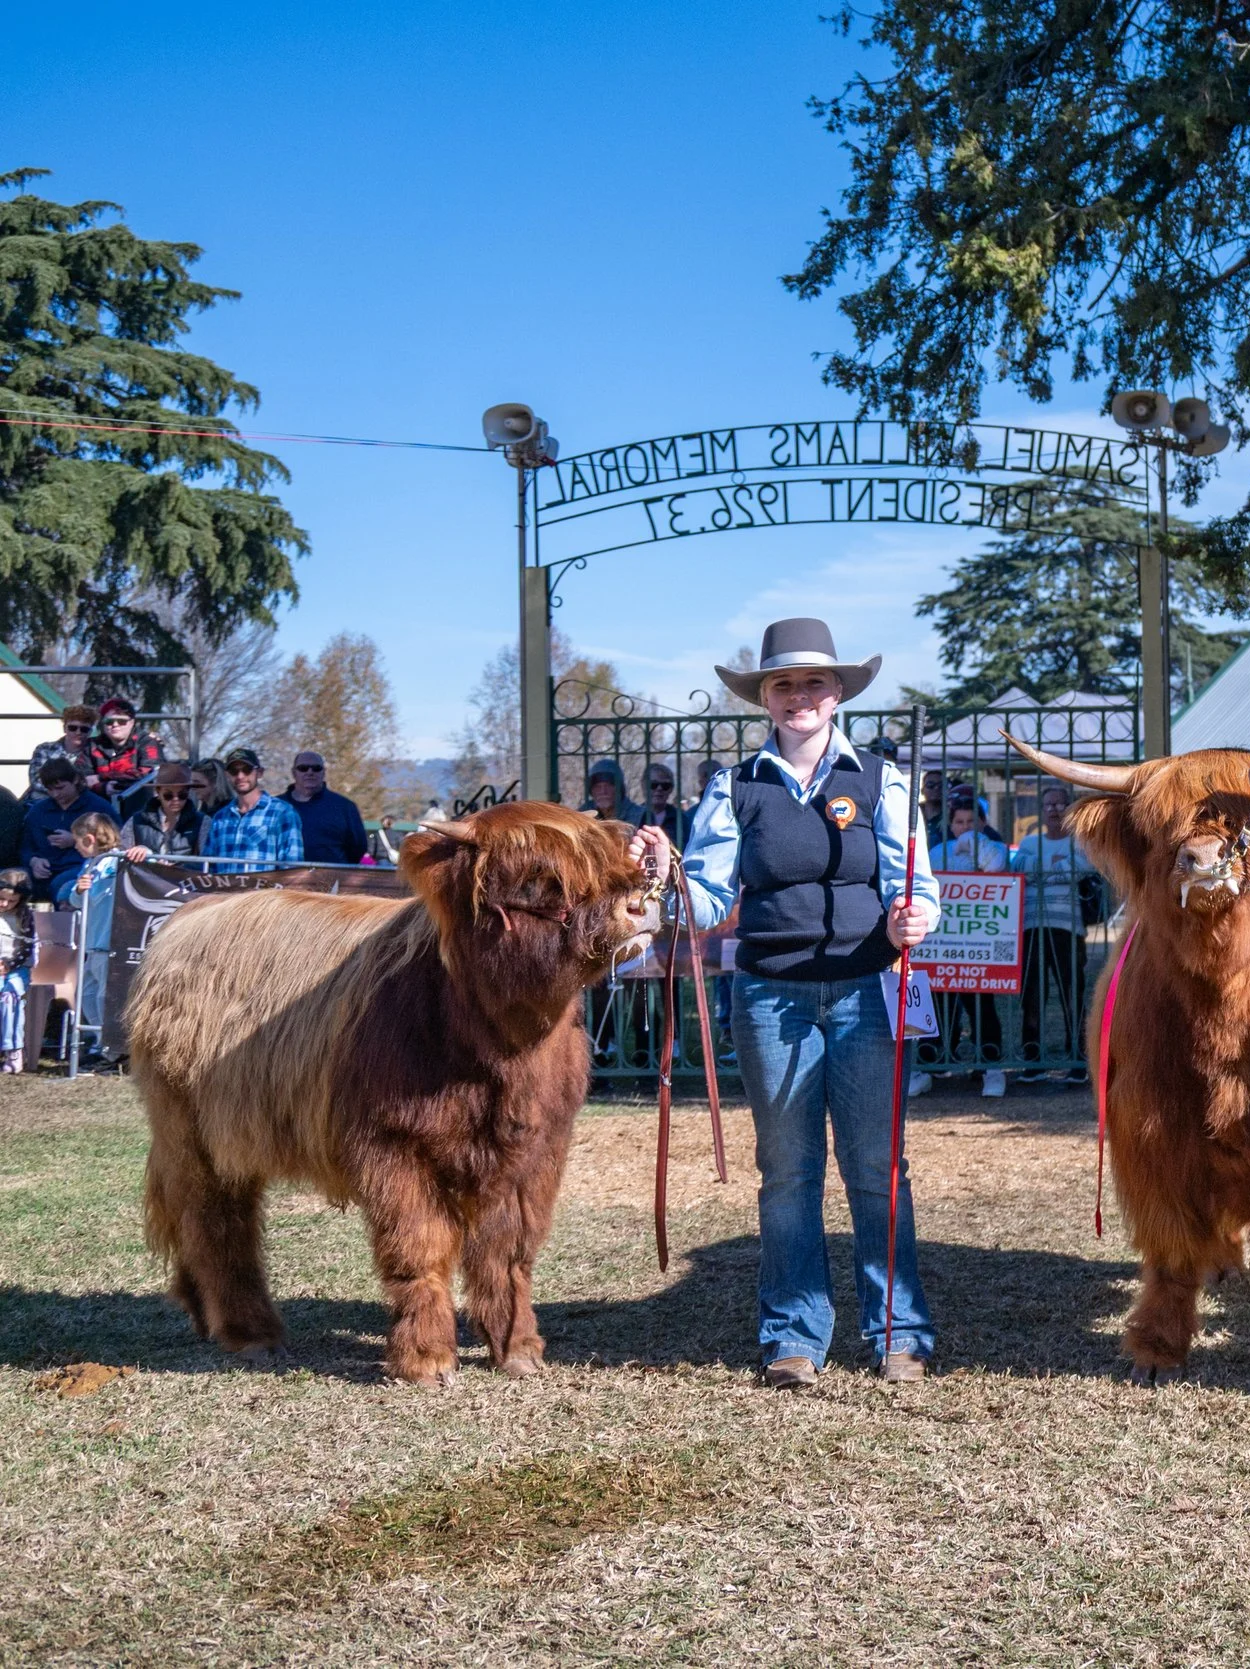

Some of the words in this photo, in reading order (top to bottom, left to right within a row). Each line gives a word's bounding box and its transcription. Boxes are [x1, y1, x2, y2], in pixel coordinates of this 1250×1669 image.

[940, 883, 1012, 901] UDGET
[940, 903, 1009, 919] REEN
[932, 920, 1000, 936] LIPS
[910, 948, 938, 959] 0421
[942, 949, 965, 959] 484
[968, 950, 990, 961] 053
[936, 965, 956, 976] DO
[959, 966, 987, 977] NOT
[948, 979, 977, 989] AND
[980, 979, 1017, 990] DRIVE
